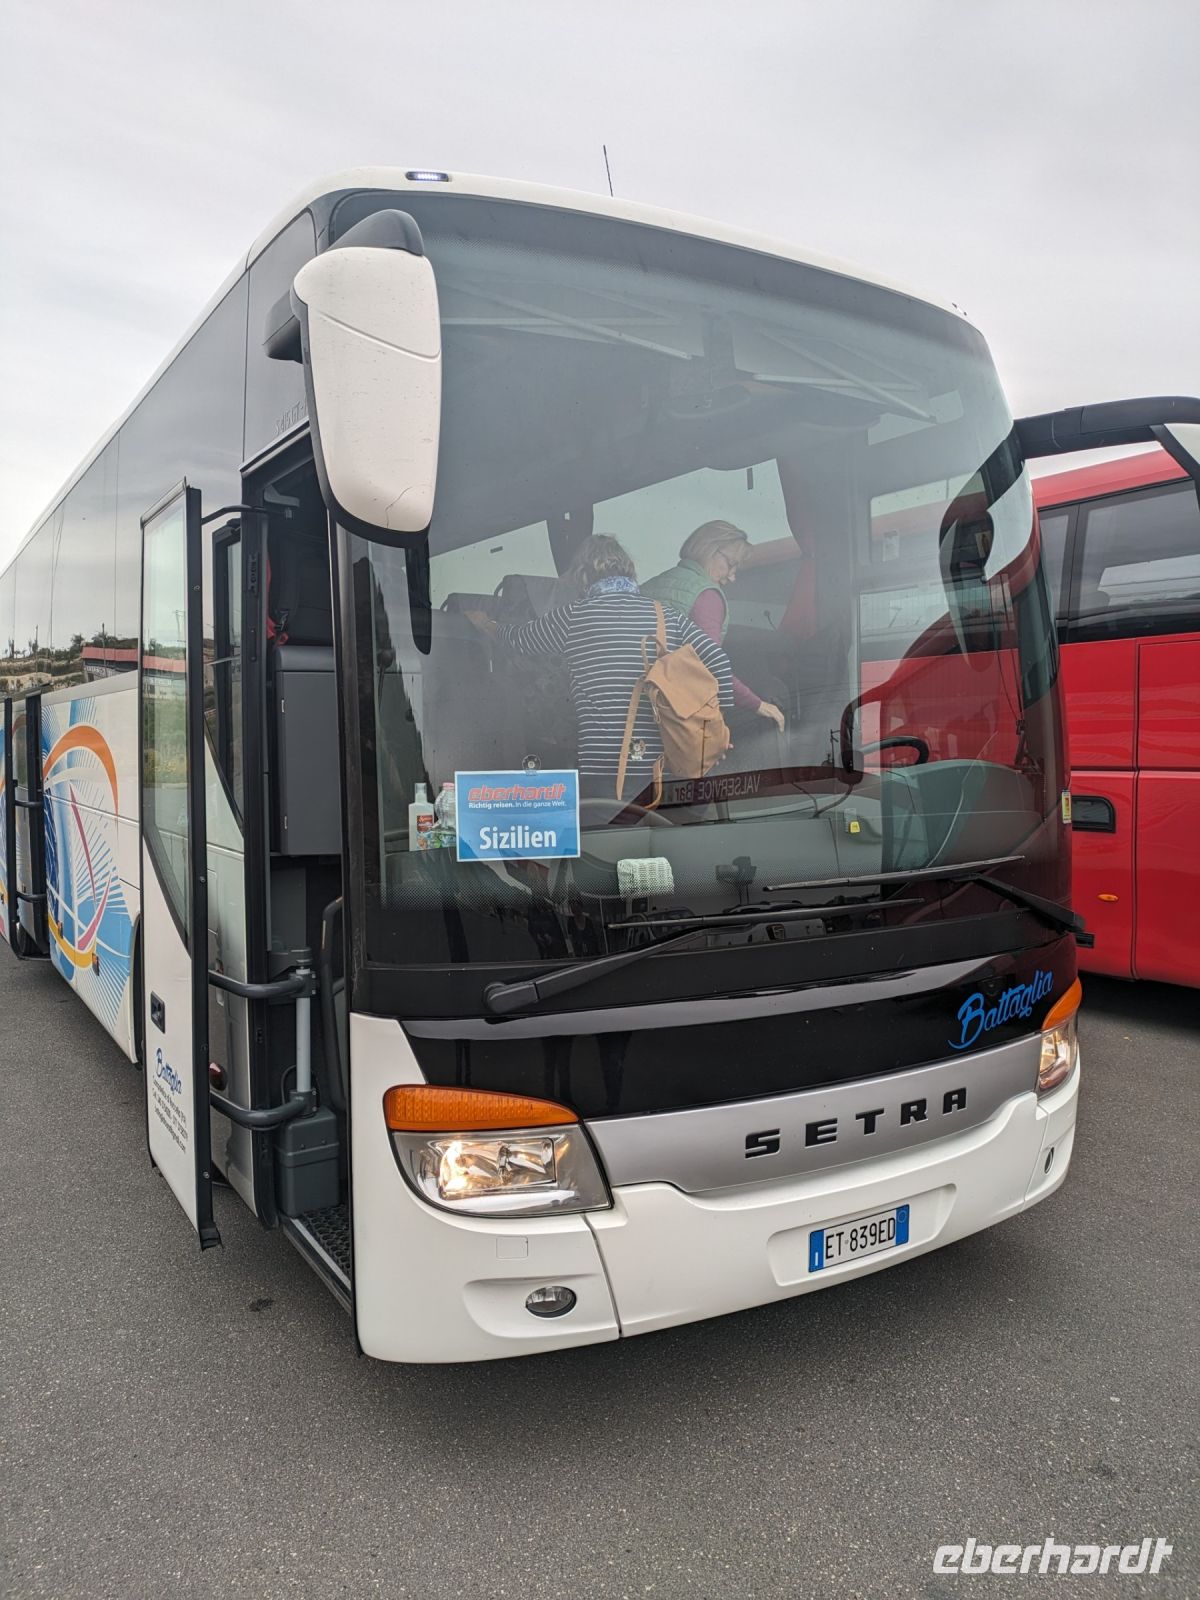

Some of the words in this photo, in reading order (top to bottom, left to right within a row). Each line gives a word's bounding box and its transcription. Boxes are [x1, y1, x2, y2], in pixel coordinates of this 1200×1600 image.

[469, 784, 565, 800] eberhardt
[479, 825, 557, 850] Sizilien
[948, 969, 1054, 1049] Battaglia
[744, 1087, 967, 1159] SETRA
[825, 1231, 844, 1260] ET
[849, 1217, 896, 1252] 839ED
